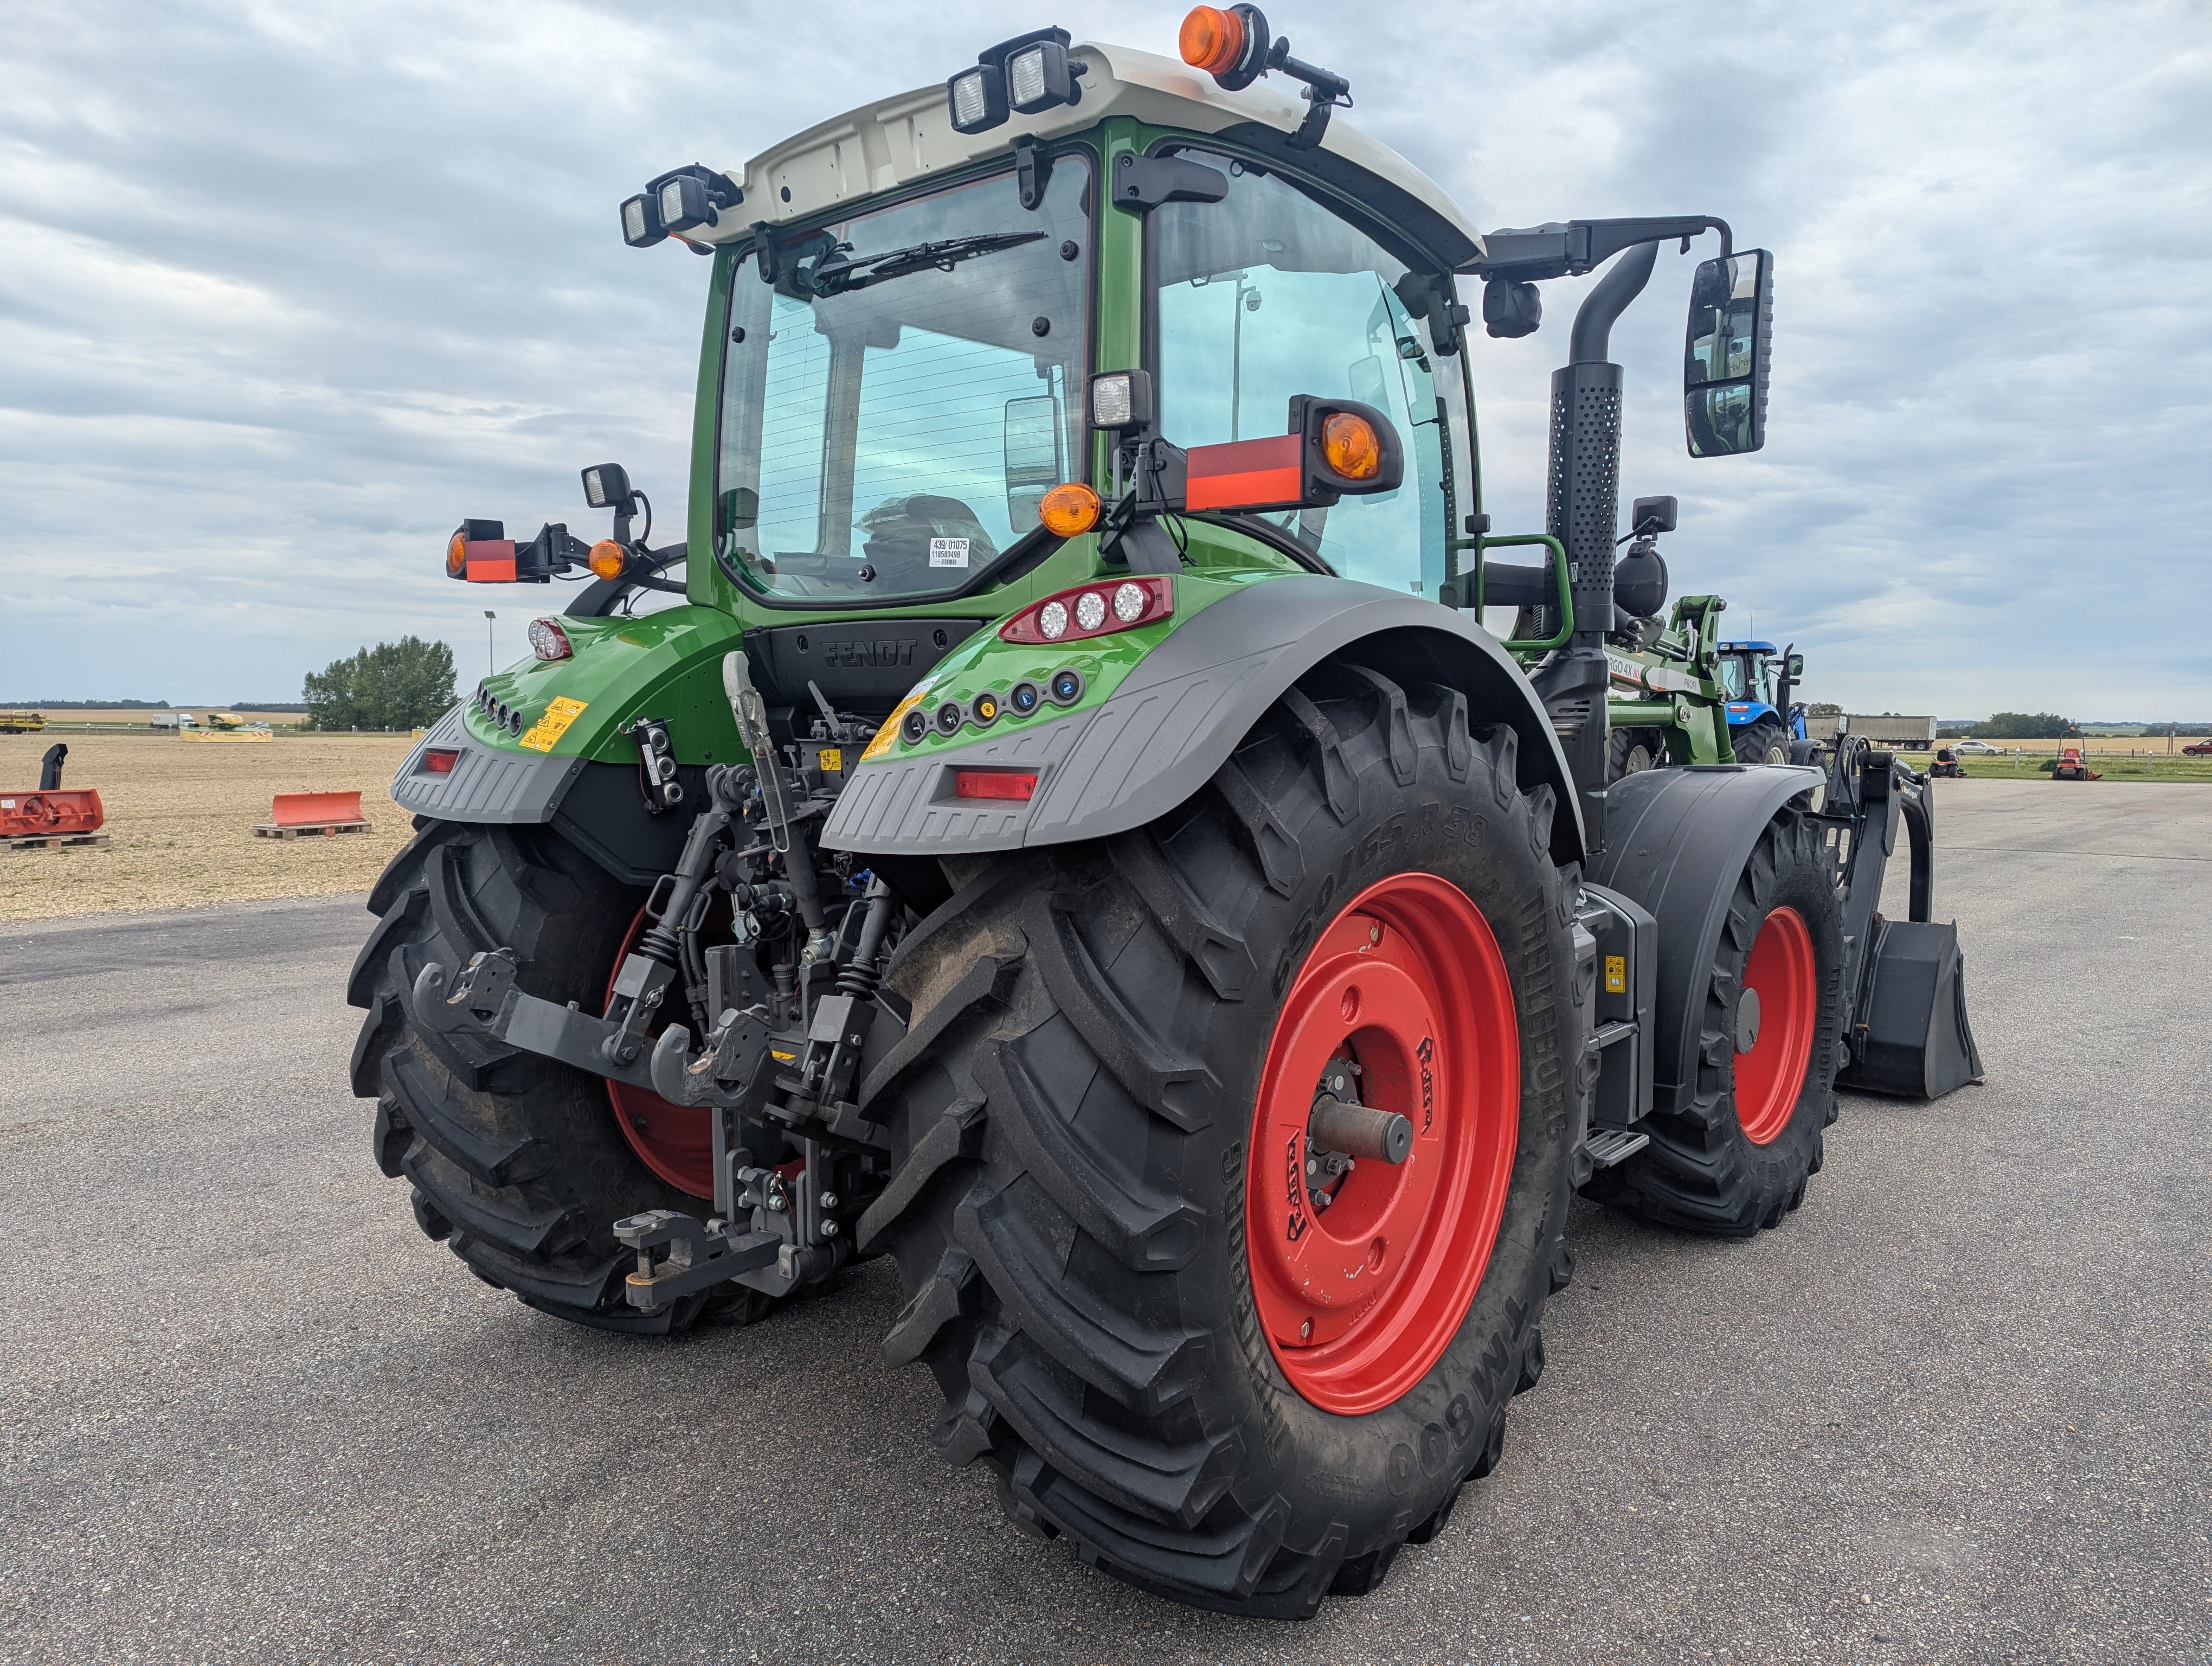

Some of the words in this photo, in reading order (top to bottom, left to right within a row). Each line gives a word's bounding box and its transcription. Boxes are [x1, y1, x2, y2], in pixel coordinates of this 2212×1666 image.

[820, 639, 917, 668] FENDT
[1624, 663, 1632, 677] 4X
[1633, 669, 1639, 679] 80
[1684, 678, 1697, 690] PROFI
[1272, 810, 1406, 1002] 650/65
[1412, 802, 1439, 840] R
[1443, 805, 1489, 848] 38
[1521, 885, 1568, 1143] TRELLEBORG
[1818, 964, 1842, 1095] TRELLEBORG
[1220, 1139, 1290, 1470] TRELLEBORG
[1385, 1295, 1529, 1498] TM800
